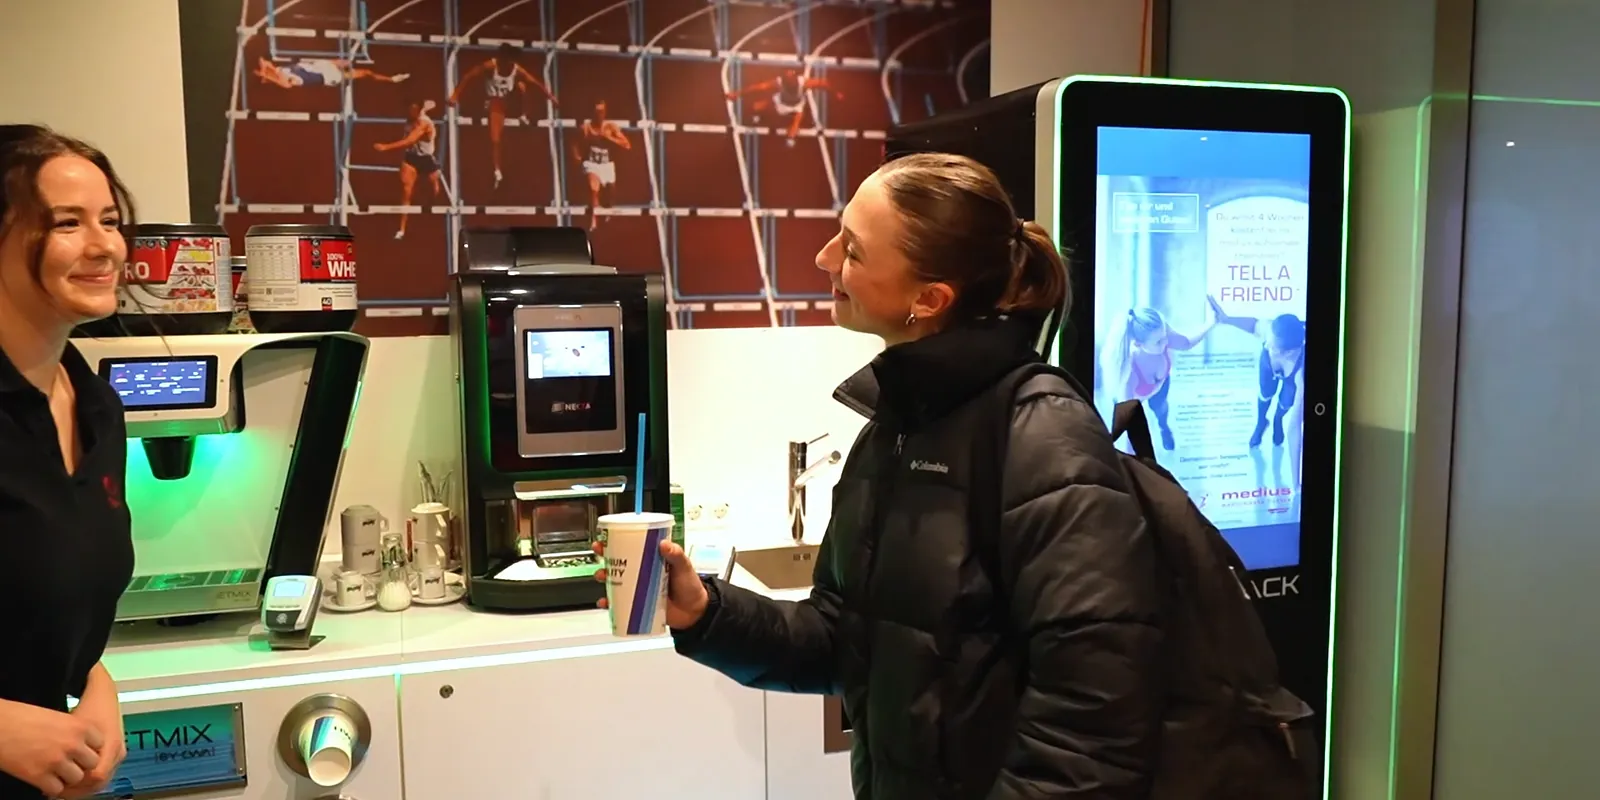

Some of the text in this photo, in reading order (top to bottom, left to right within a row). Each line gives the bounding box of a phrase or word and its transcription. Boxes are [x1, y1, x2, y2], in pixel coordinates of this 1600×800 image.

[1258, 213, 1264, 221] 4
[1228, 265, 1290, 281] TELL A
[1221, 486, 1291, 500] medius
[124, 723, 213, 751] TMIX
